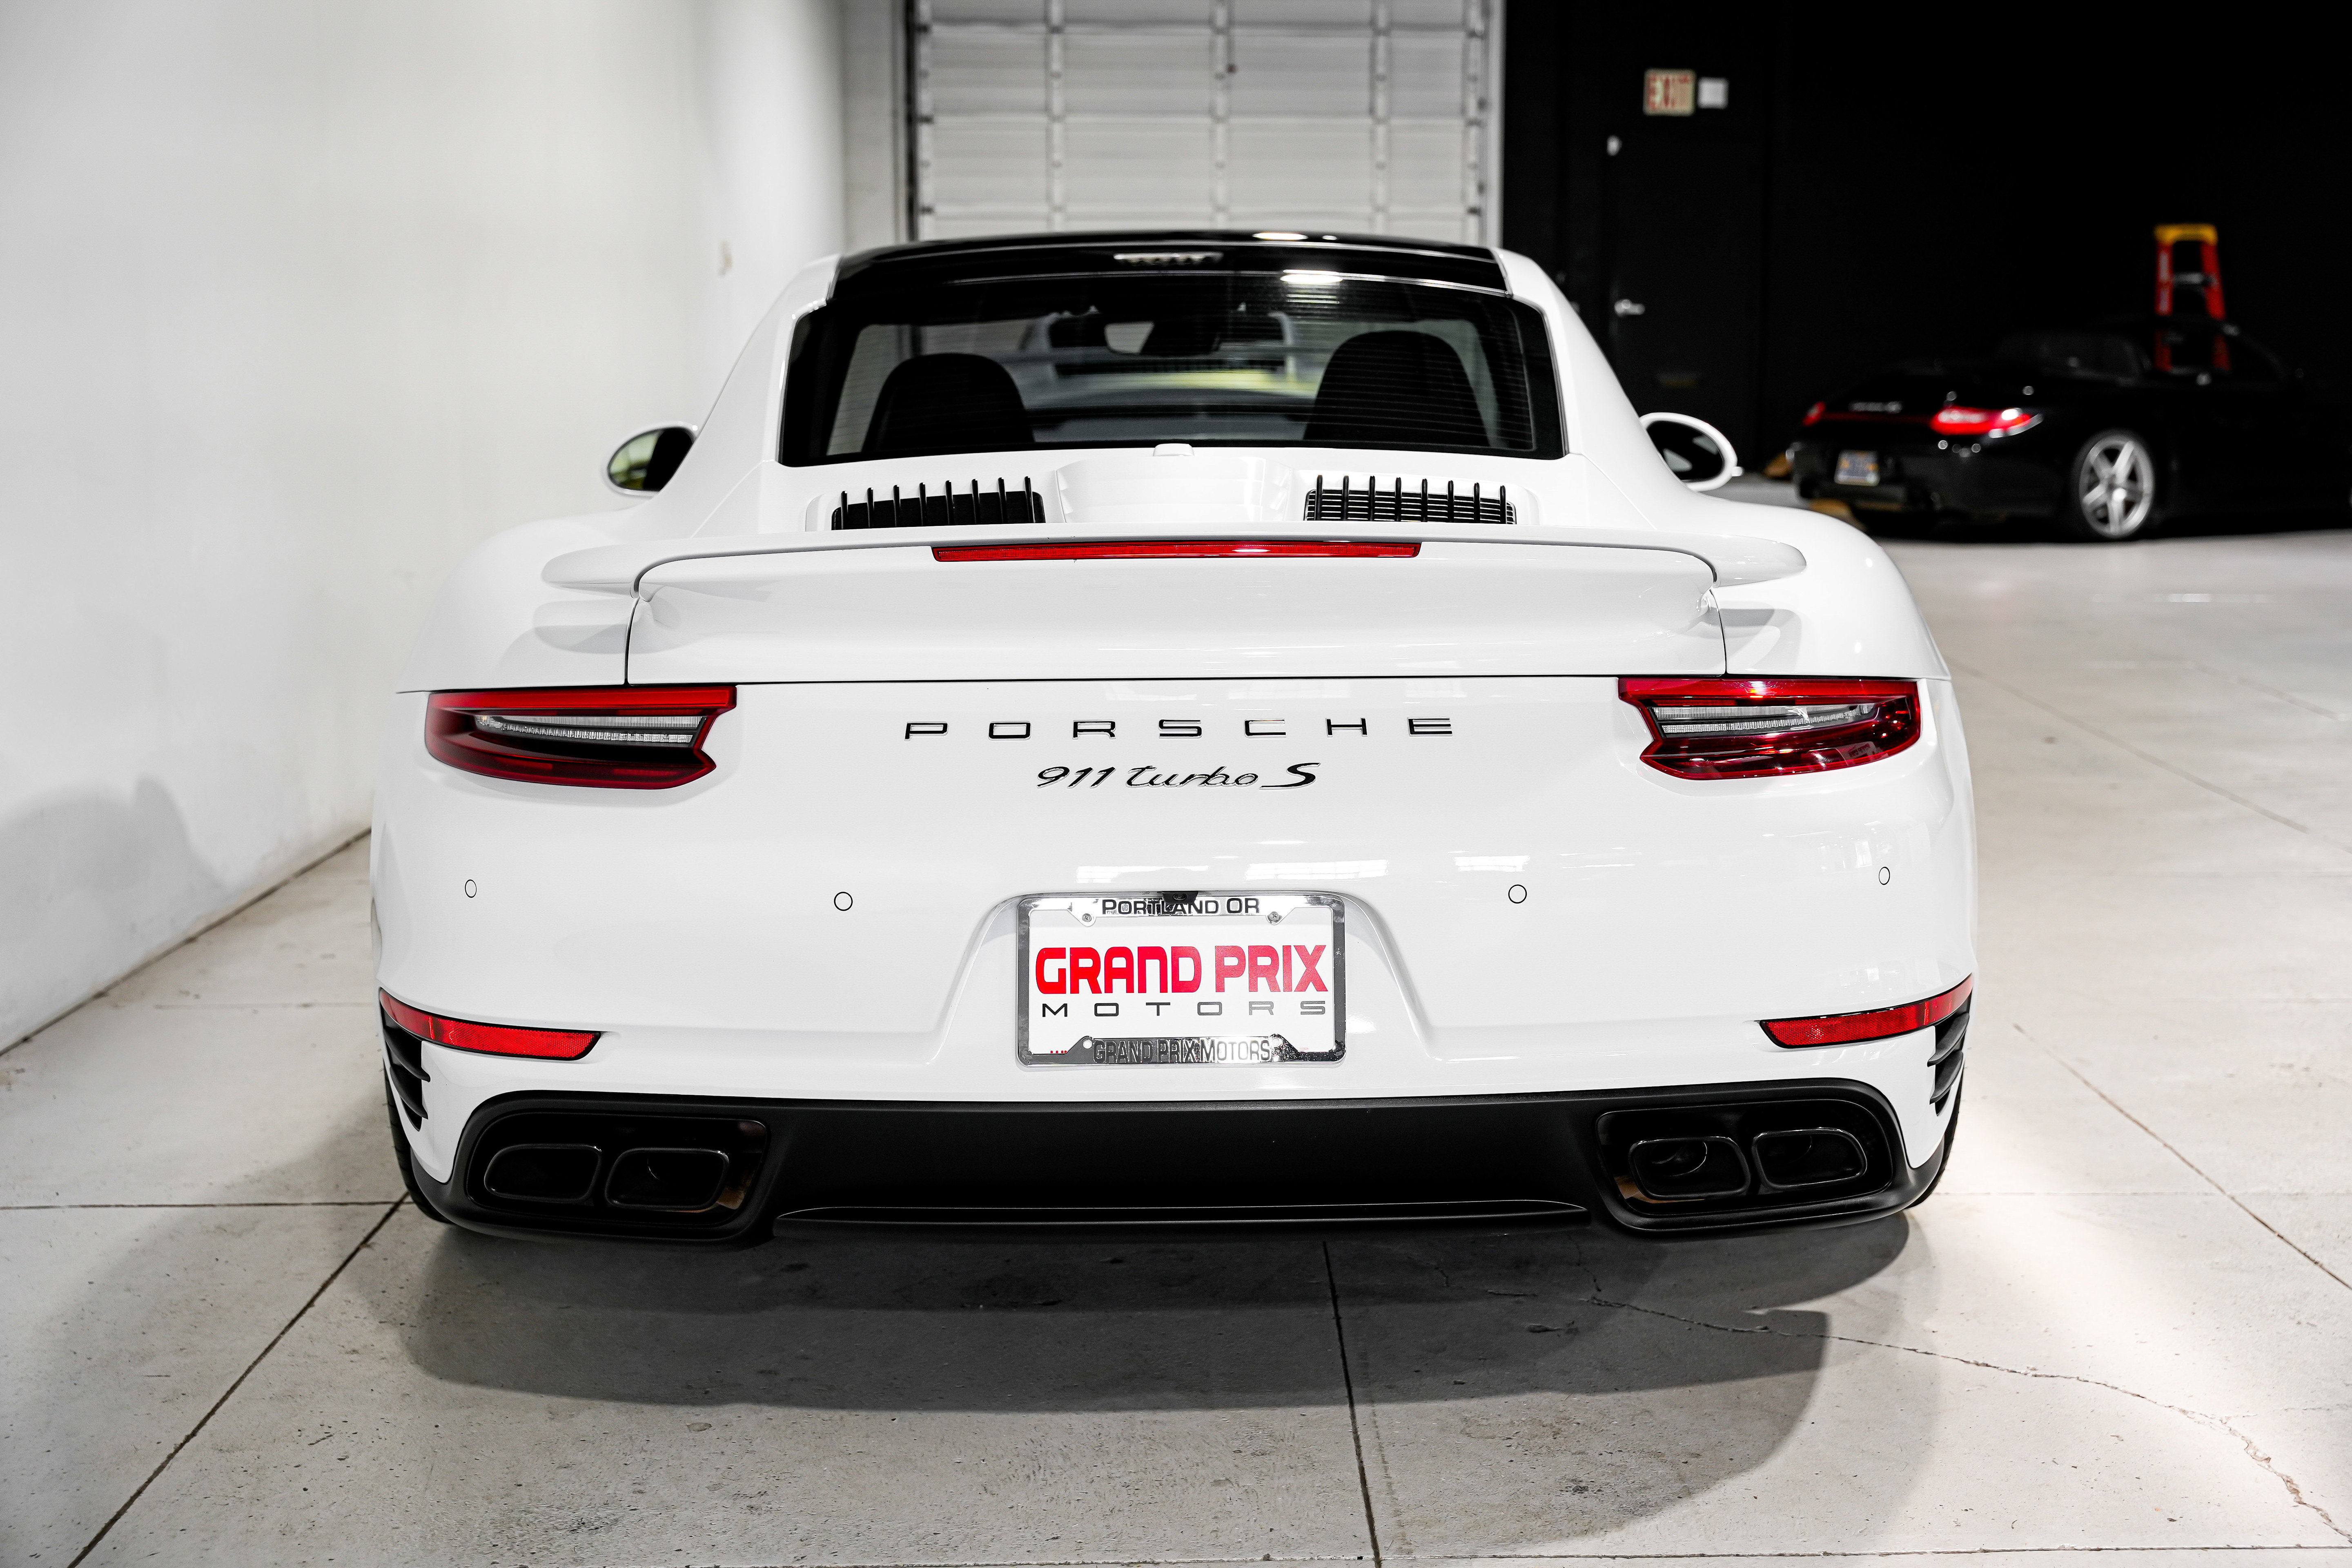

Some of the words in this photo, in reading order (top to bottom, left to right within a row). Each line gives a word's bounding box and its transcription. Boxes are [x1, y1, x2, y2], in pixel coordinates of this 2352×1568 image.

[905, 717, 1453, 740] PORSCHE
[1036, 766, 1116, 789] 911
[1125, 765, 1261, 790] turbo
[1258, 762, 1322, 791] S
[1227, 898, 1260, 913] OR
[1036, 946, 1202, 995] GRAND
[1215, 945, 1328, 993] PRIX
[1042, 1000, 1326, 1018] MOTORS
[1093, 1040, 1153, 1063] GRAND
[1157, 1040, 1198, 1062] PRIX
[1200, 1040, 1270, 1062] MOTORS
